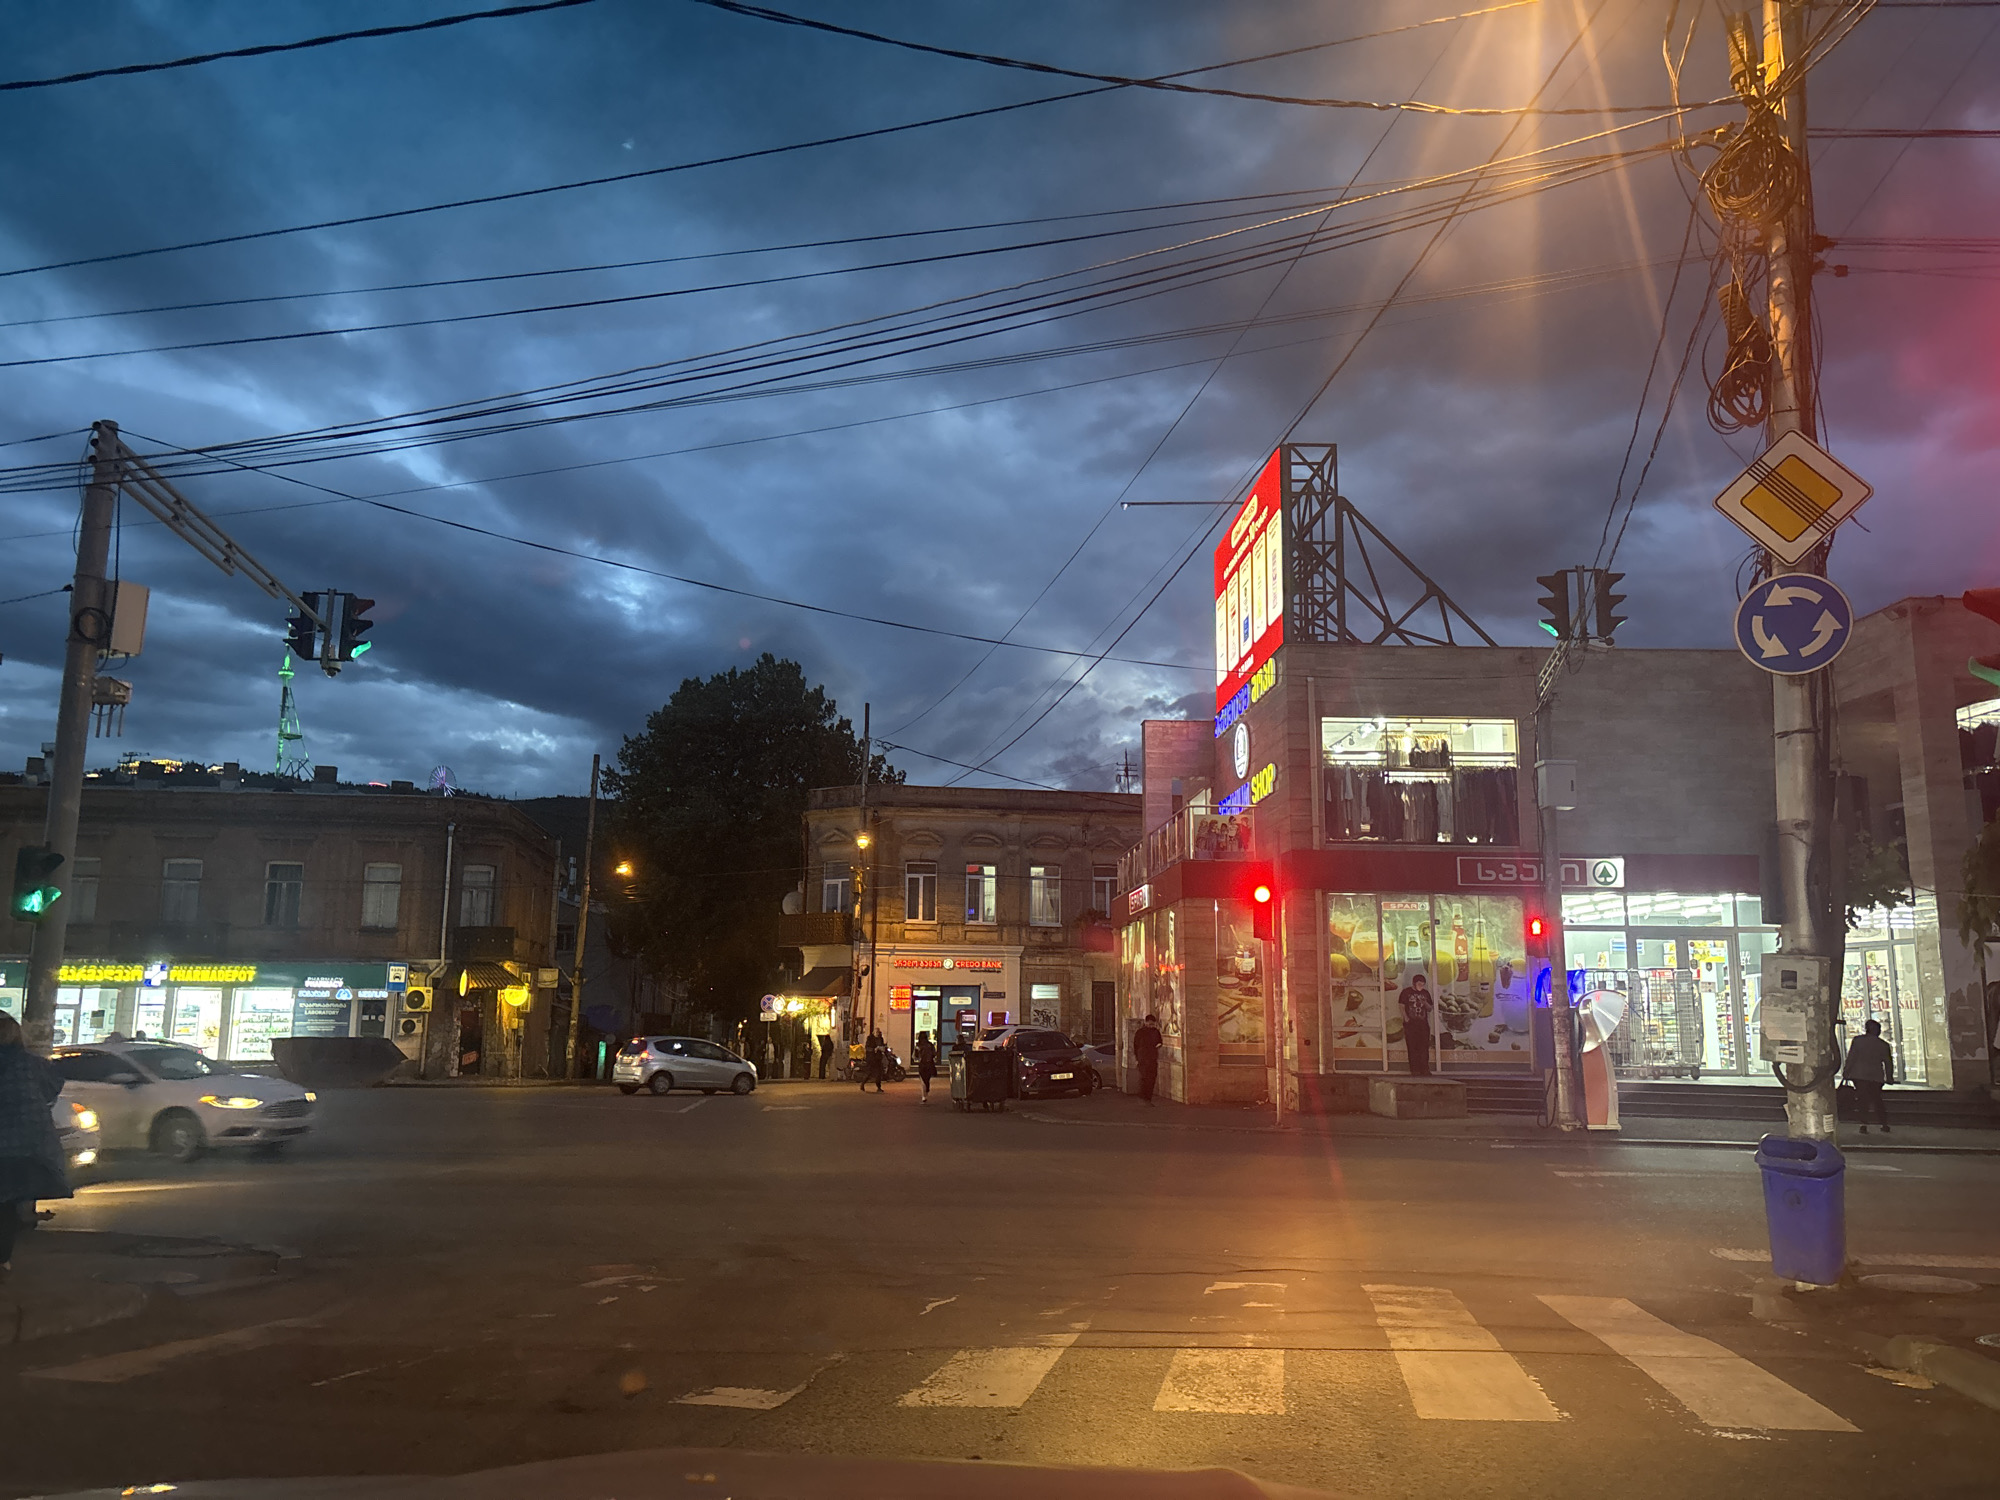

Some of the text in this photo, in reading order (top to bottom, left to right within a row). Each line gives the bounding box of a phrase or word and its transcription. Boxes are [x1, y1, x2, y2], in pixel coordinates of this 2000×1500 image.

[1251, 763, 1275, 804] SHOP
[1477, 862, 1580, 882] სპაი
[1130, 890, 1143, 911] SPAR
[170, 969, 256, 982] PHARMADEPOT
[304, 979, 344, 988] PHARMACY
[1899, 999, 1919, 1010] SALE
